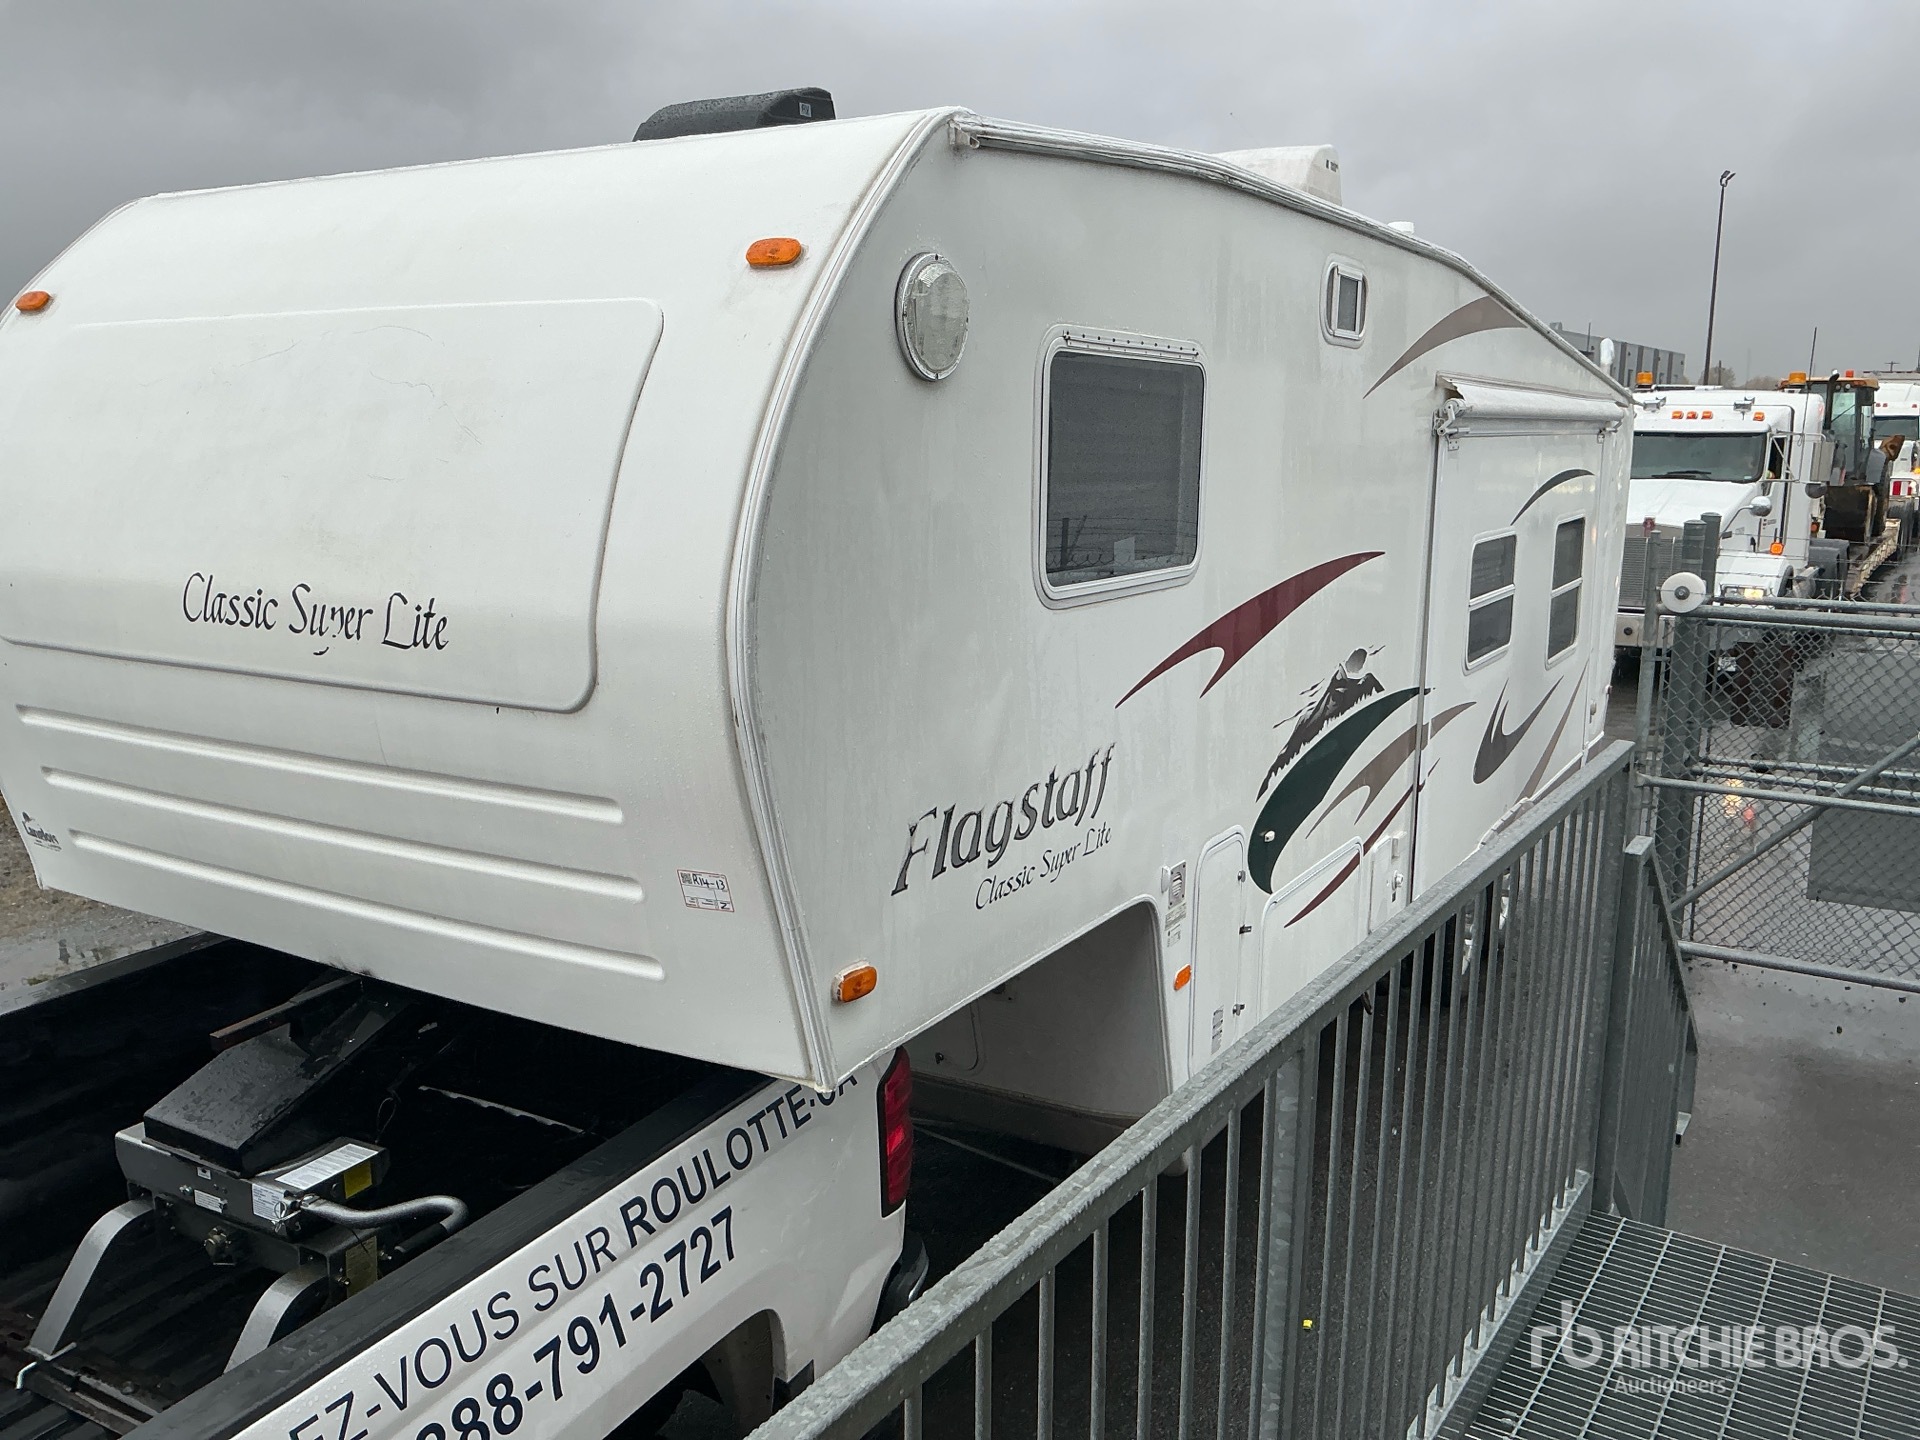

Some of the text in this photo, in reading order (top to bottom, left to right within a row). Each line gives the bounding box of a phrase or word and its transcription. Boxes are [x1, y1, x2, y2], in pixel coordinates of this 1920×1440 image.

[183, 572, 278, 630] Classic
[381, 592, 449, 650] Lite
[891, 742, 1116, 896] Flagstaff
[692, 873, 726, 891] R14-13
[975, 821, 1112, 910] Classic Super Lite
[528, 1226, 618, 1311] SUR
[415, 1205, 735, 1440] 88-791-2727
